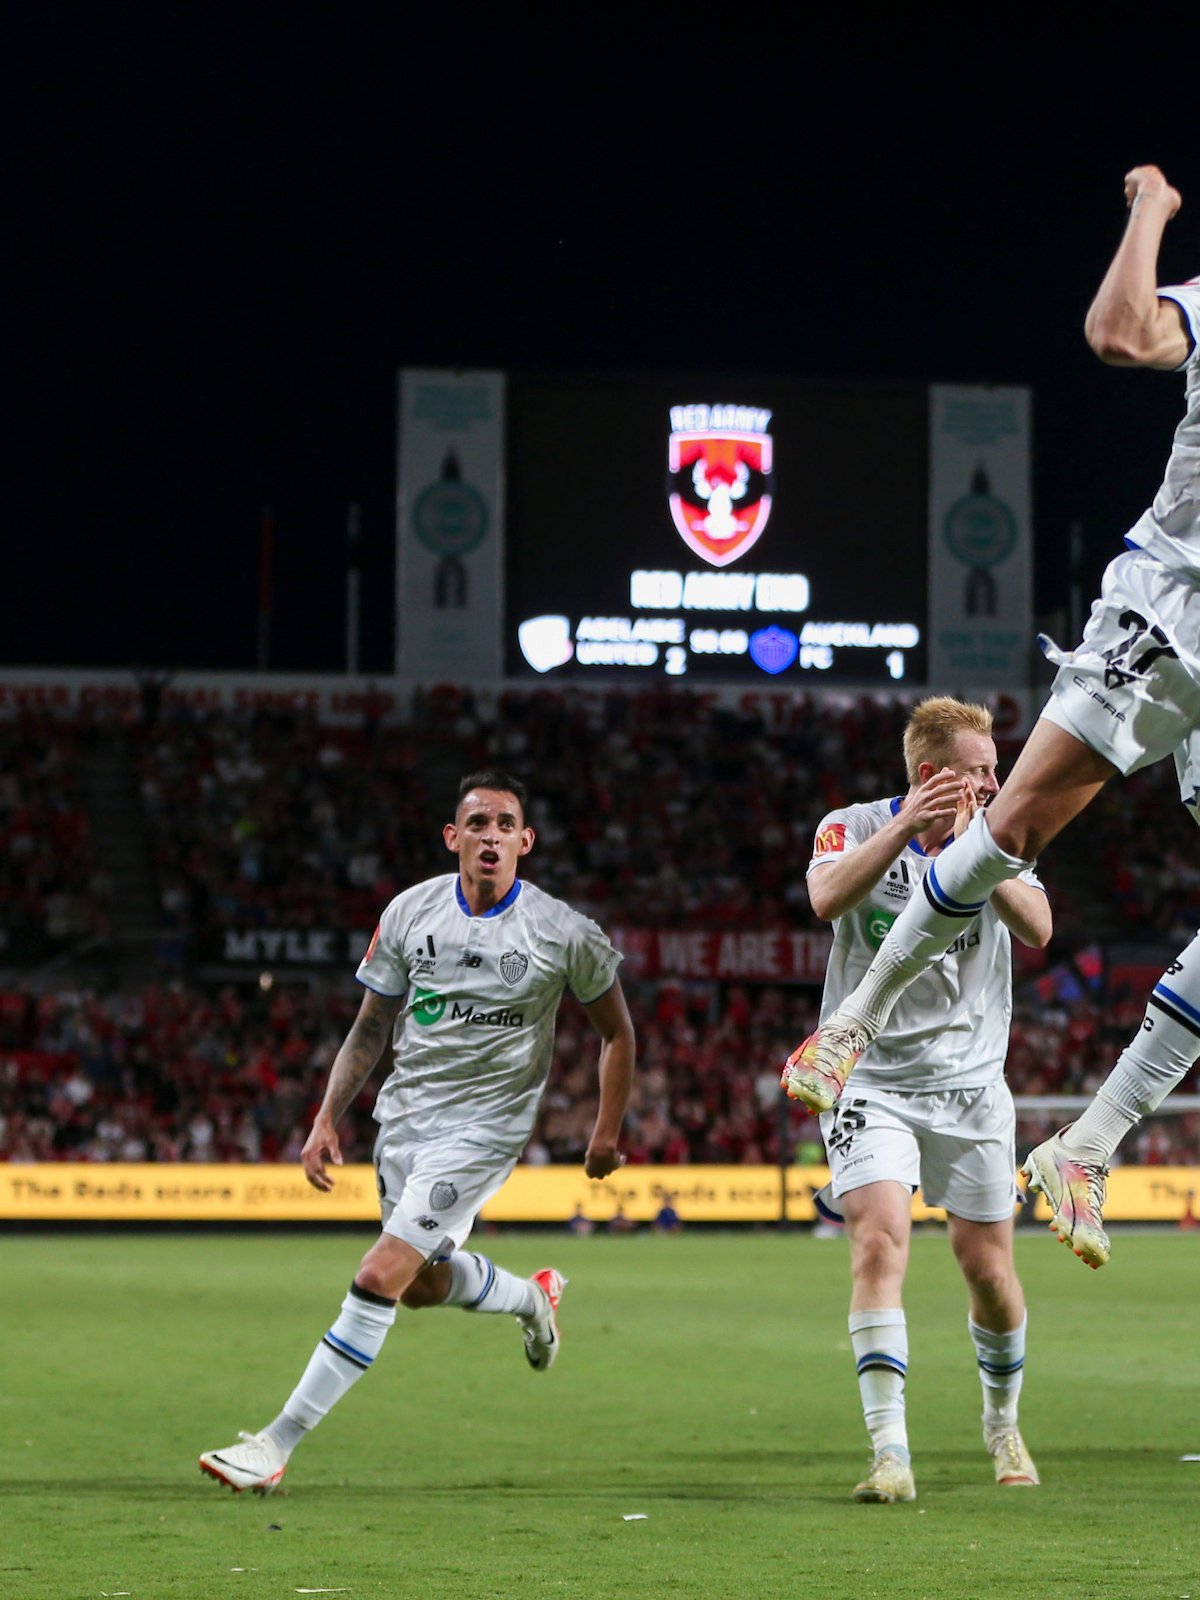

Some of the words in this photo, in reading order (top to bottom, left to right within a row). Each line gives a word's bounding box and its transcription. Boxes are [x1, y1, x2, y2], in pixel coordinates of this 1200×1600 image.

[576, 617, 684, 643] ADELAIDE
[801, 621, 919, 647] AUCKLAND
[577, 641, 659, 665] UNITED
[665, 646, 687, 675] 2
[801, 645, 833, 669] FC
[887, 651, 904, 679] 1
[1072, 675, 1127, 724] CUPRA
[869, 919, 890, 938] G
[946, 933, 980, 954] dia
[656, 929, 710, 976] WE
[716, 929, 783, 977] ARE
[450, 1001, 524, 1027] Media
[11, 1179, 61, 1201] The
[74, 1180, 142, 1201] Reds
[155, 1184, 234, 1202] score
[589, 1180, 635, 1199] The
[1150, 1182, 1195, 1203] The
